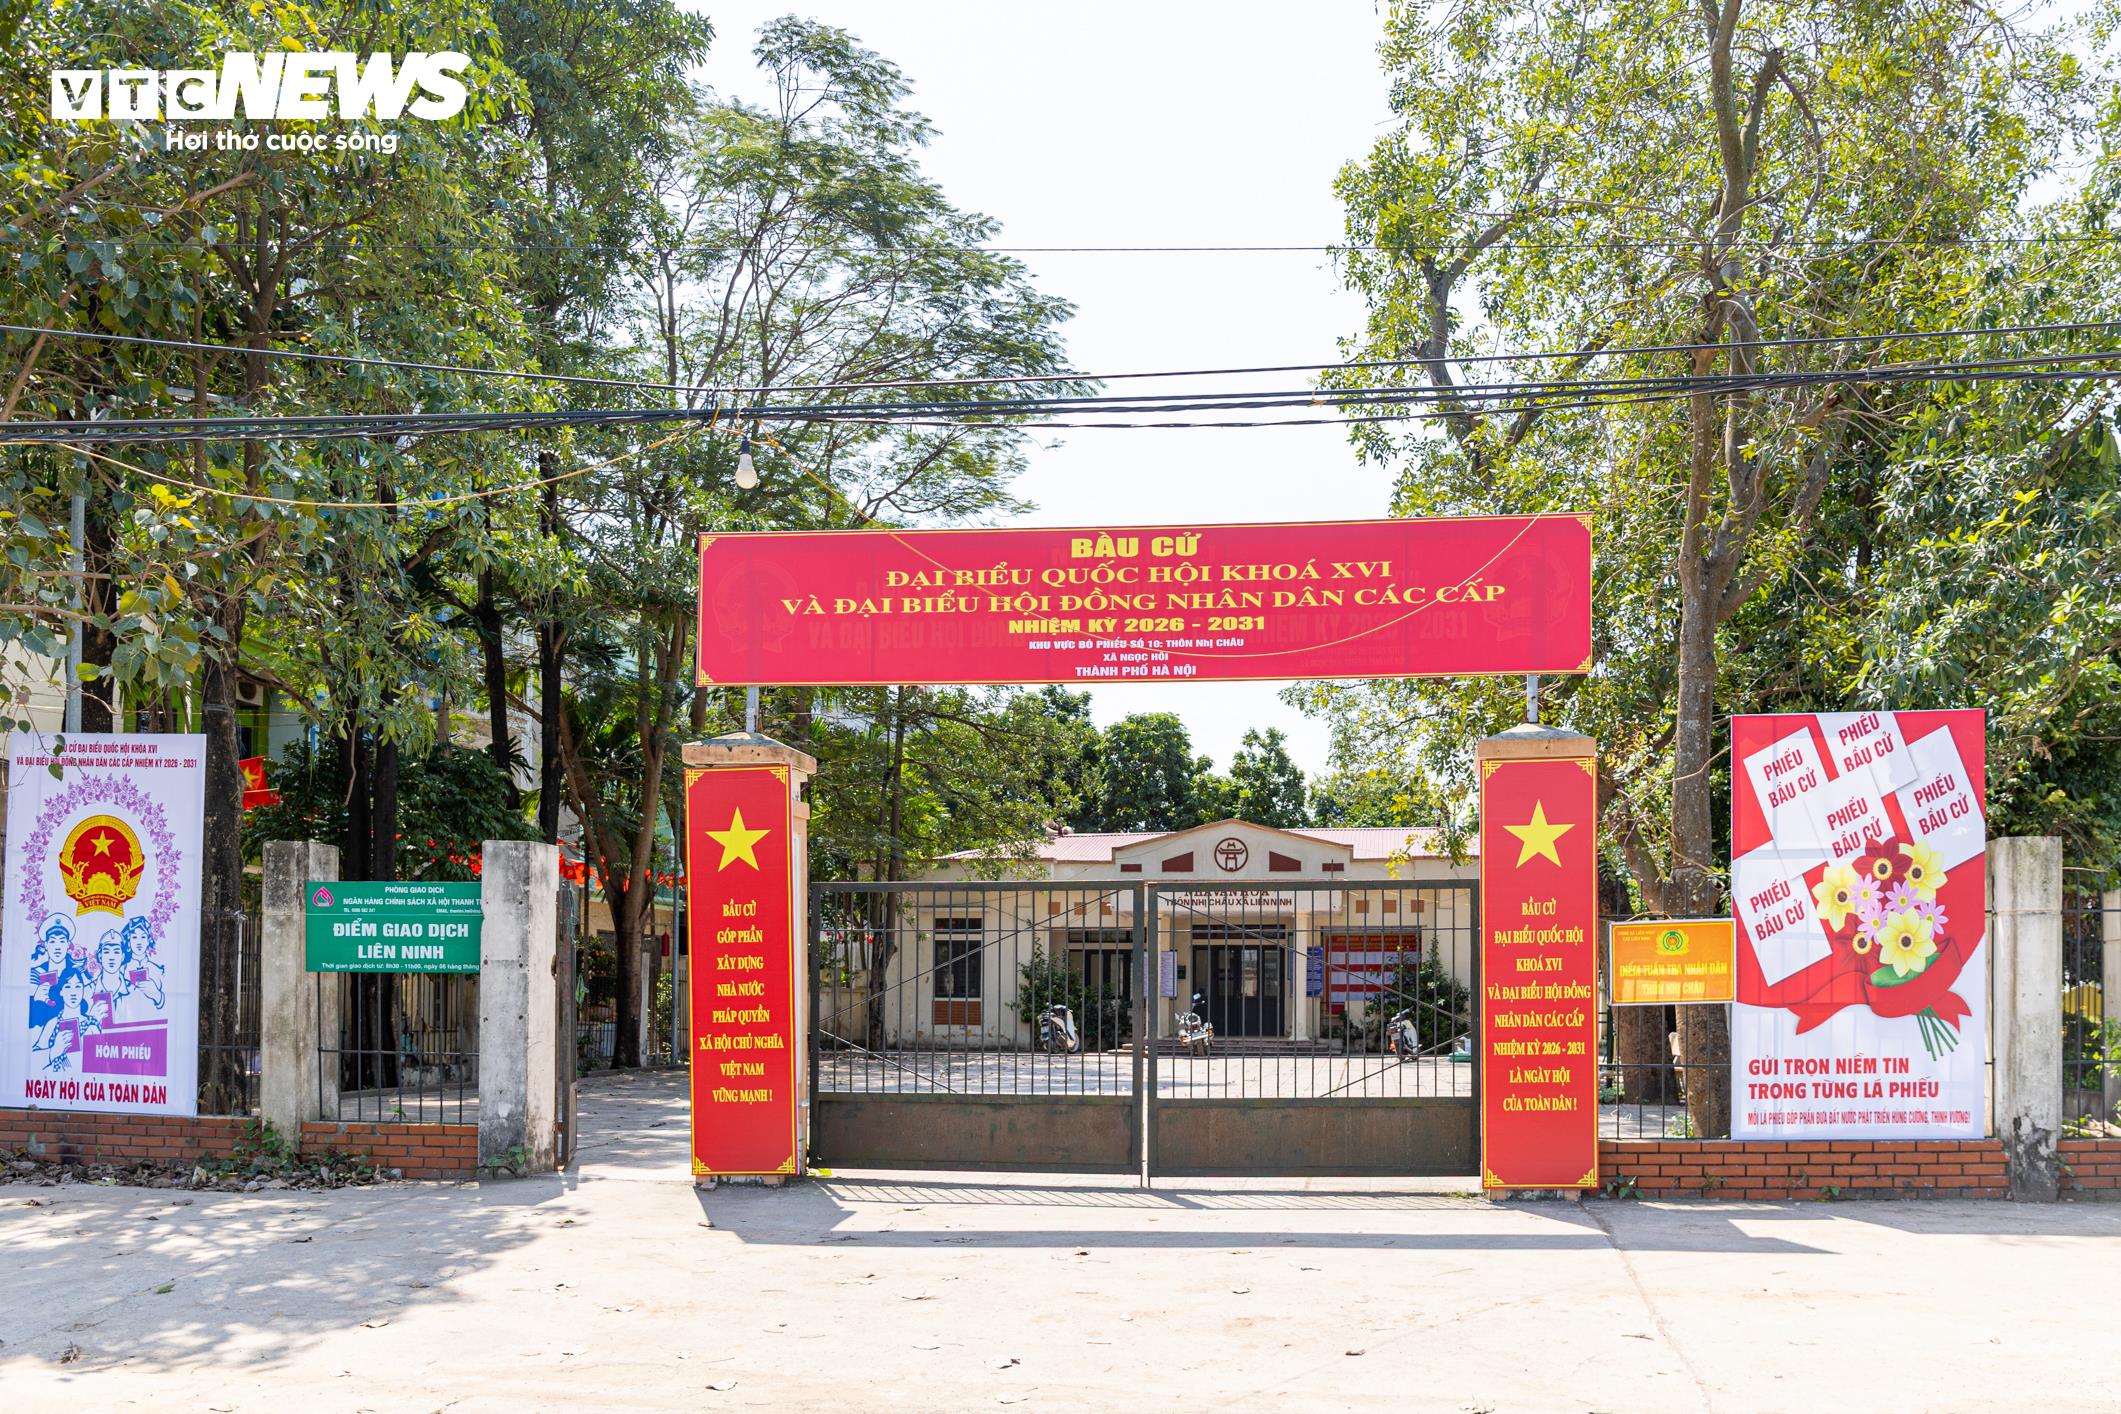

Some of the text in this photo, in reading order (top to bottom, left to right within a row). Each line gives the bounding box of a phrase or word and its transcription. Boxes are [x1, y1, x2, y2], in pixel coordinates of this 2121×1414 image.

[1071, 532, 1202, 558] BẦU CỬ
[885, 559, 1393, 591] ĐẠI BIỂU QUỐC HỘI KHOÁ XVI
[780, 578, 1506, 618] VÀ ĐẠI BIỂU HỘI ĐỒNG NHÂN DÂN CÁC CẤP
[1008, 617, 1080, 636] NHIỆM
[1088, 616, 1118, 633] KỲ
[1124, 617, 1185, 632] 2026
[1207, 616, 1265, 631] 2031
[1029, 637, 1245, 651] KHU VỰC BỎ PHIẾU SỐ 10: THÔN CHÂU
[1103, 652, 1117, 662] XÃ
[1119, 653, 1149, 663] NGỌC
[1075, 663, 1197, 677] THÀNH PHỐ HÀ NỘI
[1838, 711, 1880, 746] PHIẾU
[104, 741, 119, 754] QUỐC
[120, 742, 130, 756] HỘI
[148, 744, 157, 754] XVI
[1843, 732, 1894, 773] BẦU CỬ
[163, 759, 178, 768] 2026
[183, 759, 197, 768] 2031
[1763, 747, 1804, 782] PHIẾU
[1767, 766, 1817, 809] BẦU CỬ
[1913, 772, 1956, 808] PHIẾU
[1826, 796, 1868, 831] PHIẾU
[1918, 793, 1969, 836] BẦU CỬ
[1832, 817, 1883, 859] BẦU CỬ
[385, 885, 445, 895] PHÒNG GIAO DỊCH
[1751, 878, 1791, 914] PHIẾU
[364, 897, 384, 905] HÀNG
[407, 897, 426, 906] SÁCH
[438, 897, 450, 907] HỘI
[452, 898, 475, 906] THANH
[722, 898, 757, 917] BẦU CỬ
[1521, 896, 1557, 916] BẦU CỬ
[333, 918, 469, 940] ĐIỂM GIAO DỊCH
[1755, 899, 1805, 942] BẦU CỬ
[716, 924, 763, 944] GÓP PHẦN
[1494, 924, 1584, 947] ĐẠI BIỂU QUỐC HỘI
[357, 942, 444, 959] LIÊN NINH
[716, 953, 764, 973] XÂY DỰNG
[1515, 954, 1563, 972] KHOÁ XVI
[717, 979, 764, 997] NHÀ NƯỚC
[1487, 979, 1591, 1003] VÀ ĐẠI BIỂU HỘI ĐỒNG
[712, 1003, 770, 1025] PHÁP QUYỀN
[1494, 1007, 1585, 1028] NHÂN DÂN CÁC CẤP
[95, 1040, 151, 1060] HÒM PHIẾU
[699, 1032, 784, 1052] XÃ HỘI CHỦ NGHĨA
[1493, 1038, 1586, 1058] NHIỆM KỲ 2026 2031
[720, 1060, 764, 1079] VIỆT NAM
[1748, 1052, 1910, 1077] GỬI TRỌN NIỀM TIN
[1509, 1066, 1570, 1085] LÀ NGÀY HỘI
[25, 1076, 167, 1105] NGÀY HỘI CỦA TOÀN DÂN
[712, 1086, 768, 1105] VỮNG MẠNH
[1748, 1075, 1940, 1100] TRONG TỪNG LÁ PHIẾU
[1503, 1094, 1572, 1111] CỦA TOÀN DÂN
